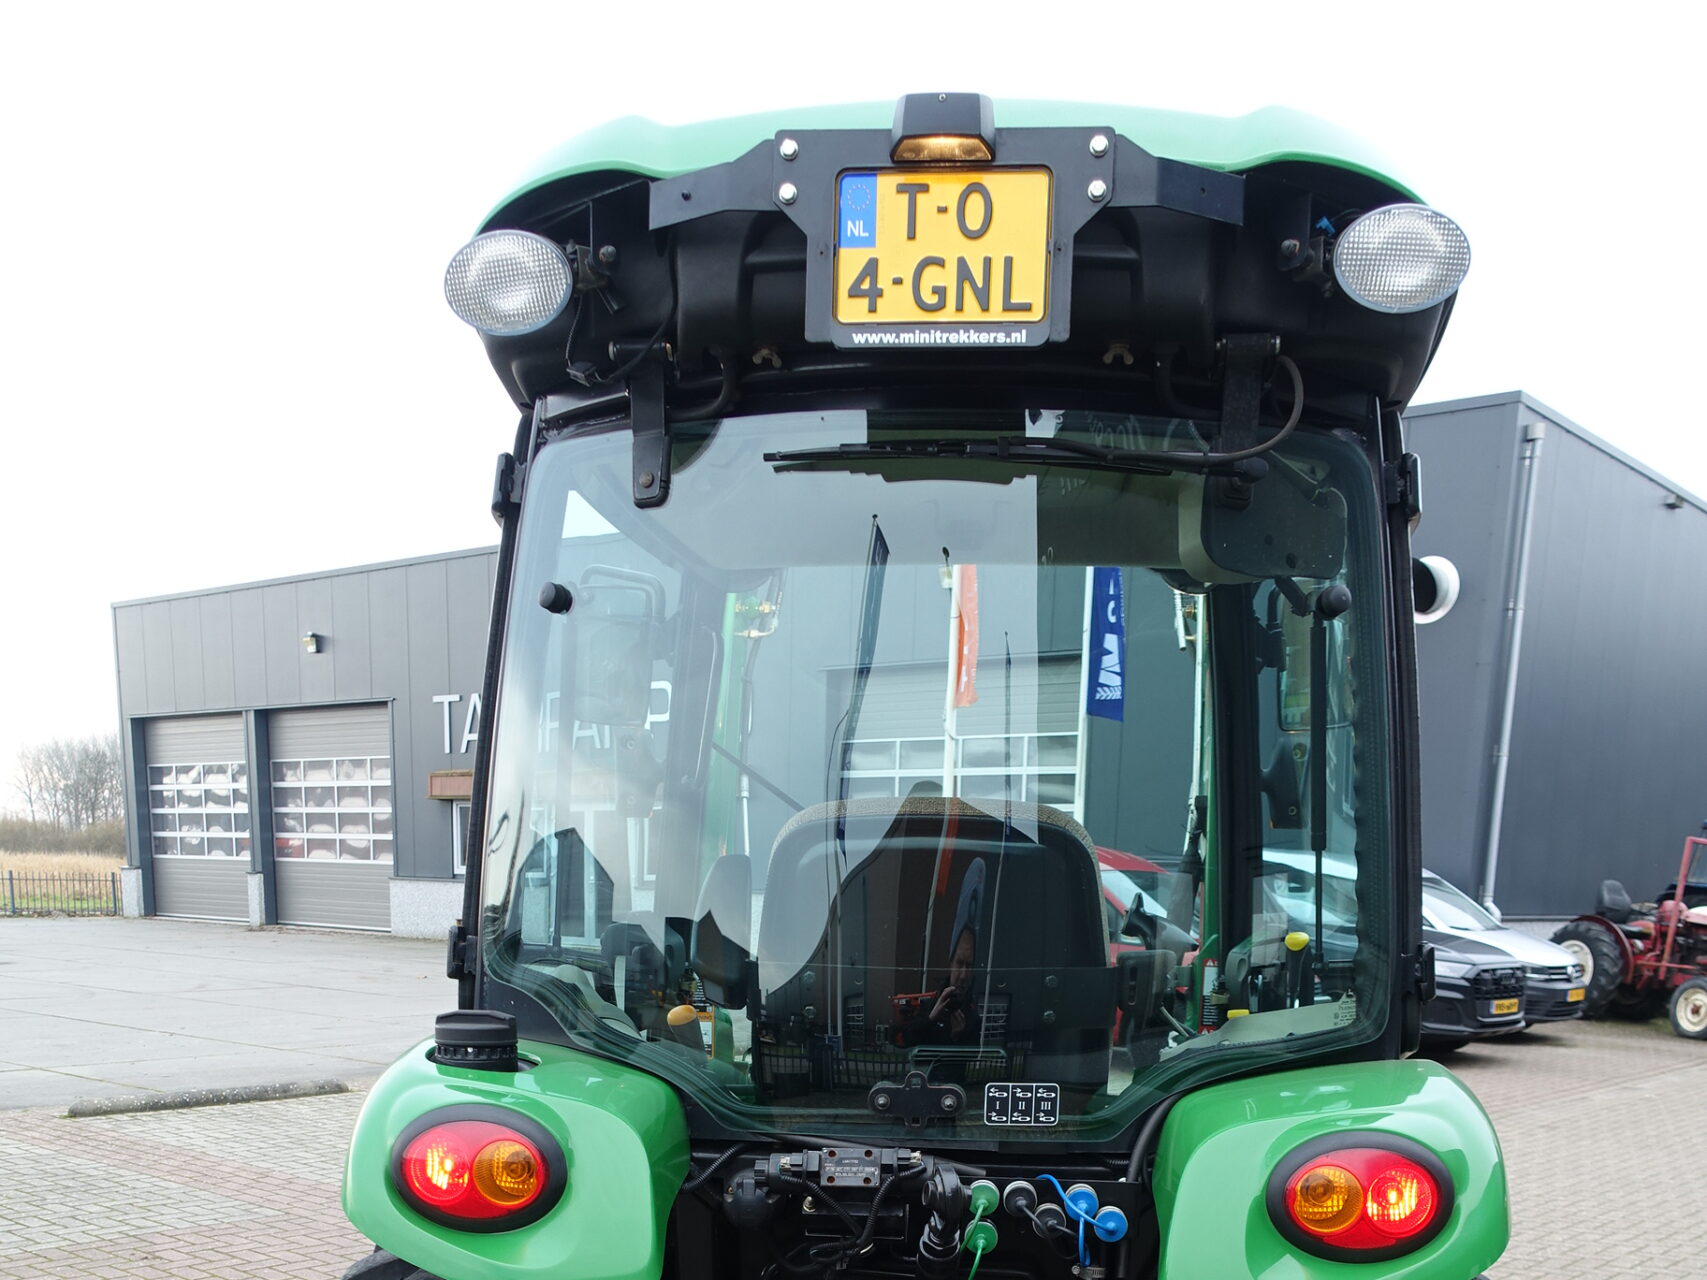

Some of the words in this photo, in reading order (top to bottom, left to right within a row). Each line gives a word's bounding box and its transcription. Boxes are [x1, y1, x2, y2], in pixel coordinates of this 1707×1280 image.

[847, 220, 869, 237] NL
[847, 255, 1033, 313] 4-GNL
[852, 329, 1027, 345] www.minitrekkers.nl
